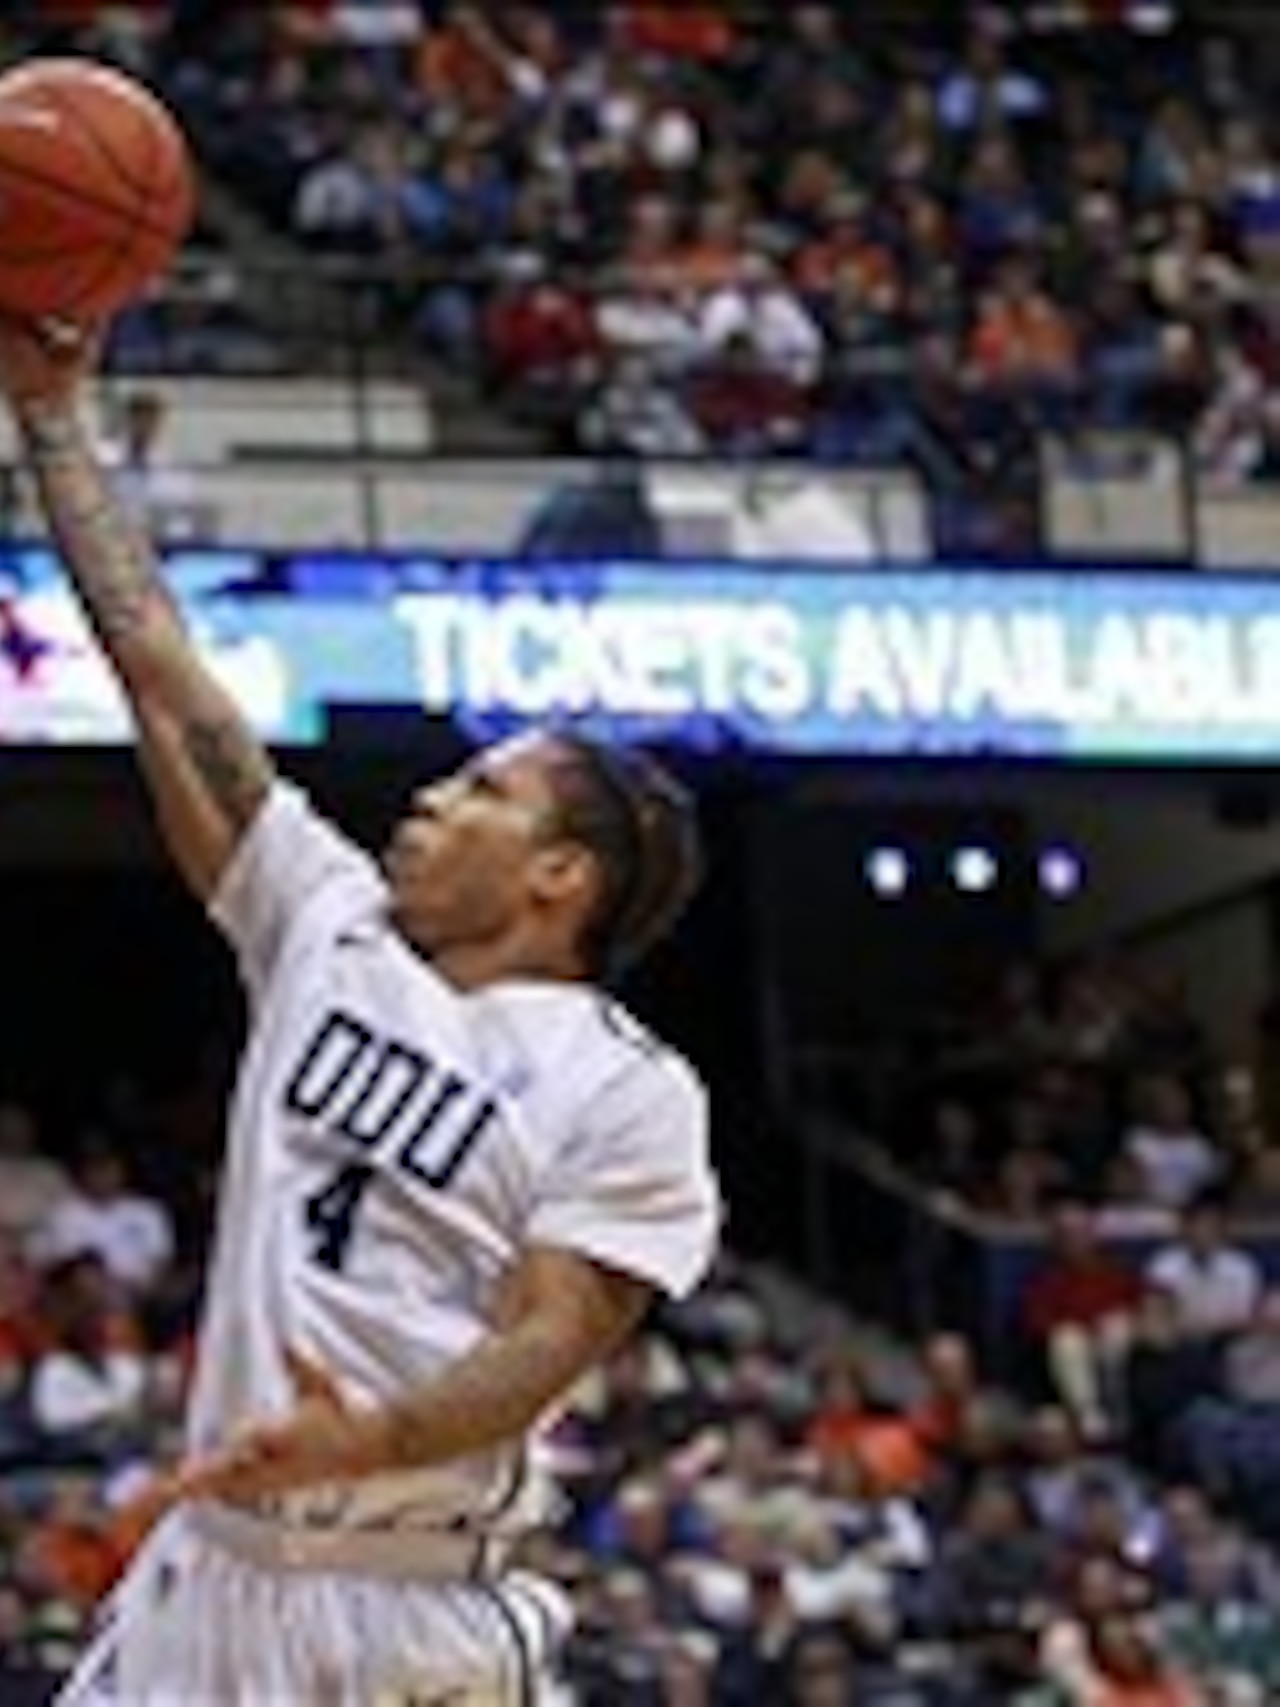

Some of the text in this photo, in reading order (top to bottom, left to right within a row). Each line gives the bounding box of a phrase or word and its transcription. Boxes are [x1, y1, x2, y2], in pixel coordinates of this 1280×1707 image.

[395, 594, 810, 718] TICKETS
[286, 1008, 496, 1190] ODU
[304, 1163, 375, 1273] 4
